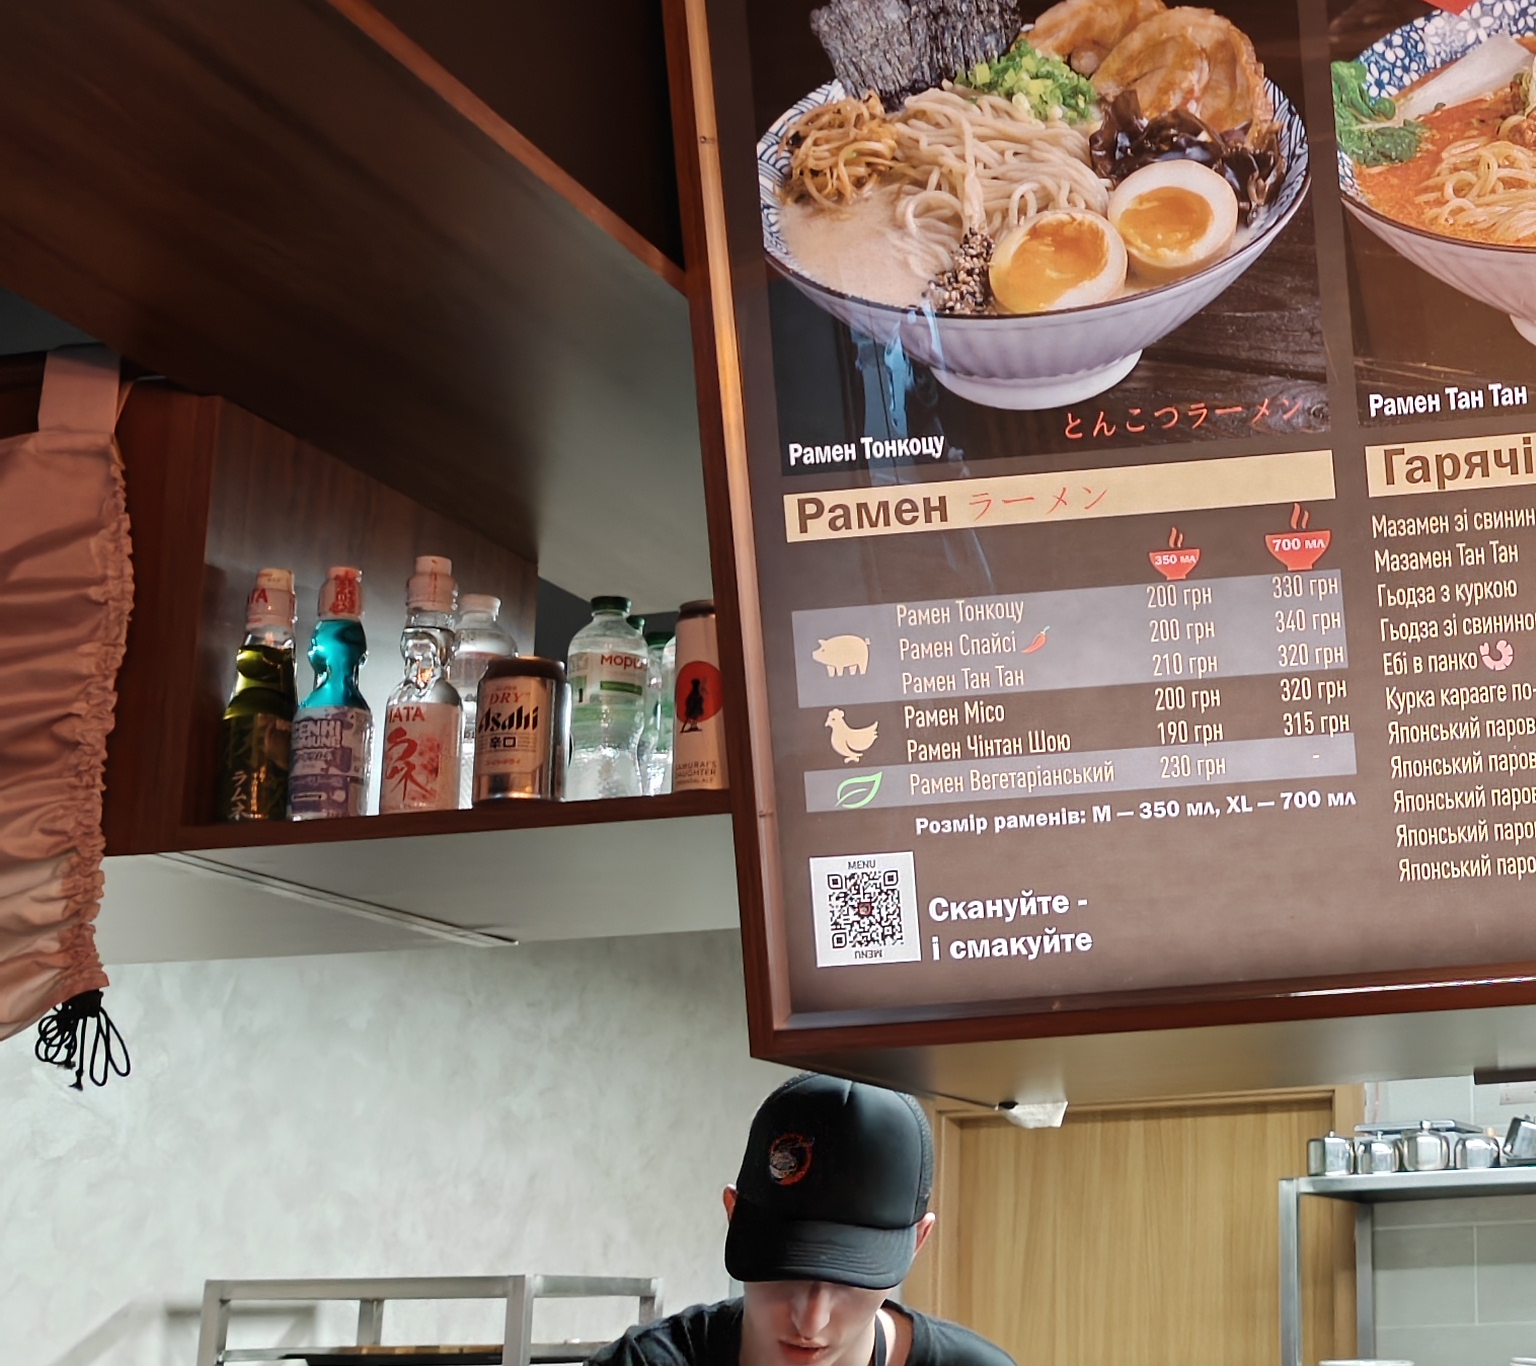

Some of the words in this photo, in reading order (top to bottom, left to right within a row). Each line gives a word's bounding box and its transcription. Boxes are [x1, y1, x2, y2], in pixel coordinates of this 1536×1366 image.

[1369, 393, 1441, 418] Рамен
[1444, 387, 1484, 411] Тан
[1488, 383, 1528, 407] Тан
[788, 443, 857, 466] Рамен
[860, 435, 945, 460] Тонкоцу
[1383, 436, 1534, 490] Гарячі
[796, 495, 948, 534] Рамен
[1371, 514, 1450, 539] Мазамен
[1454, 508, 1469, 532] зі
[1146, 584, 1177, 608] 200
[1183, 587, 1212, 611] грн
[1272, 574, 1303, 599] 330
[1309, 577, 1338, 601] грн
[1377, 583, 1436, 609] Гьодза
[1440, 584, 1451, 603] з
[1455, 579, 1518, 607] куркою
[896, 604, 951, 627] Рамен
[955, 599, 1024, 624] Тонкоцу
[899, 638, 953, 661] Рамен
[959, 630, 1016, 656] Спайсі
[1383, 651, 1408, 676] Ебі
[1413, 656, 1423, 674] в
[1428, 652, 1478, 673] панко
[902, 672, 956, 695] Рамен
[960, 667, 990, 690] Тан
[994, 665, 1024, 687] Тан
[1385, 686, 1435, 714] Курка
[1440, 684, 1507, 711] карааге
[477, 705, 539, 734] Asahi
[904, 705, 959, 729] Рамен
[964, 700, 1005, 725] Місо
[1388, 716, 1481, 745] Японський
[907, 739, 962, 763] Рамен
[967, 735, 1023, 759] Чінтан
[1027, 730, 1073, 753] Шою
[910, 773, 964, 796] Рамен
[970, 760, 1114, 793] Вегетаріанський
[915, 814, 988, 835] Розмір
[994, 807, 1086, 833] раменів:
[1139, 800, 1180, 819] 350
[1186, 801, 1221, 818] мл,
[1280, 790, 1321, 810] 700
[1327, 791, 1357, 807] мл
[1393, 784, 1486, 813] Японський
[847, 859, 876, 870] MENU
[928, 889, 1070, 923] Скануйте
[854, 949, 883, 959] MENU
[931, 936, 940, 961] і
[949, 927, 1093, 961] смакуйте
